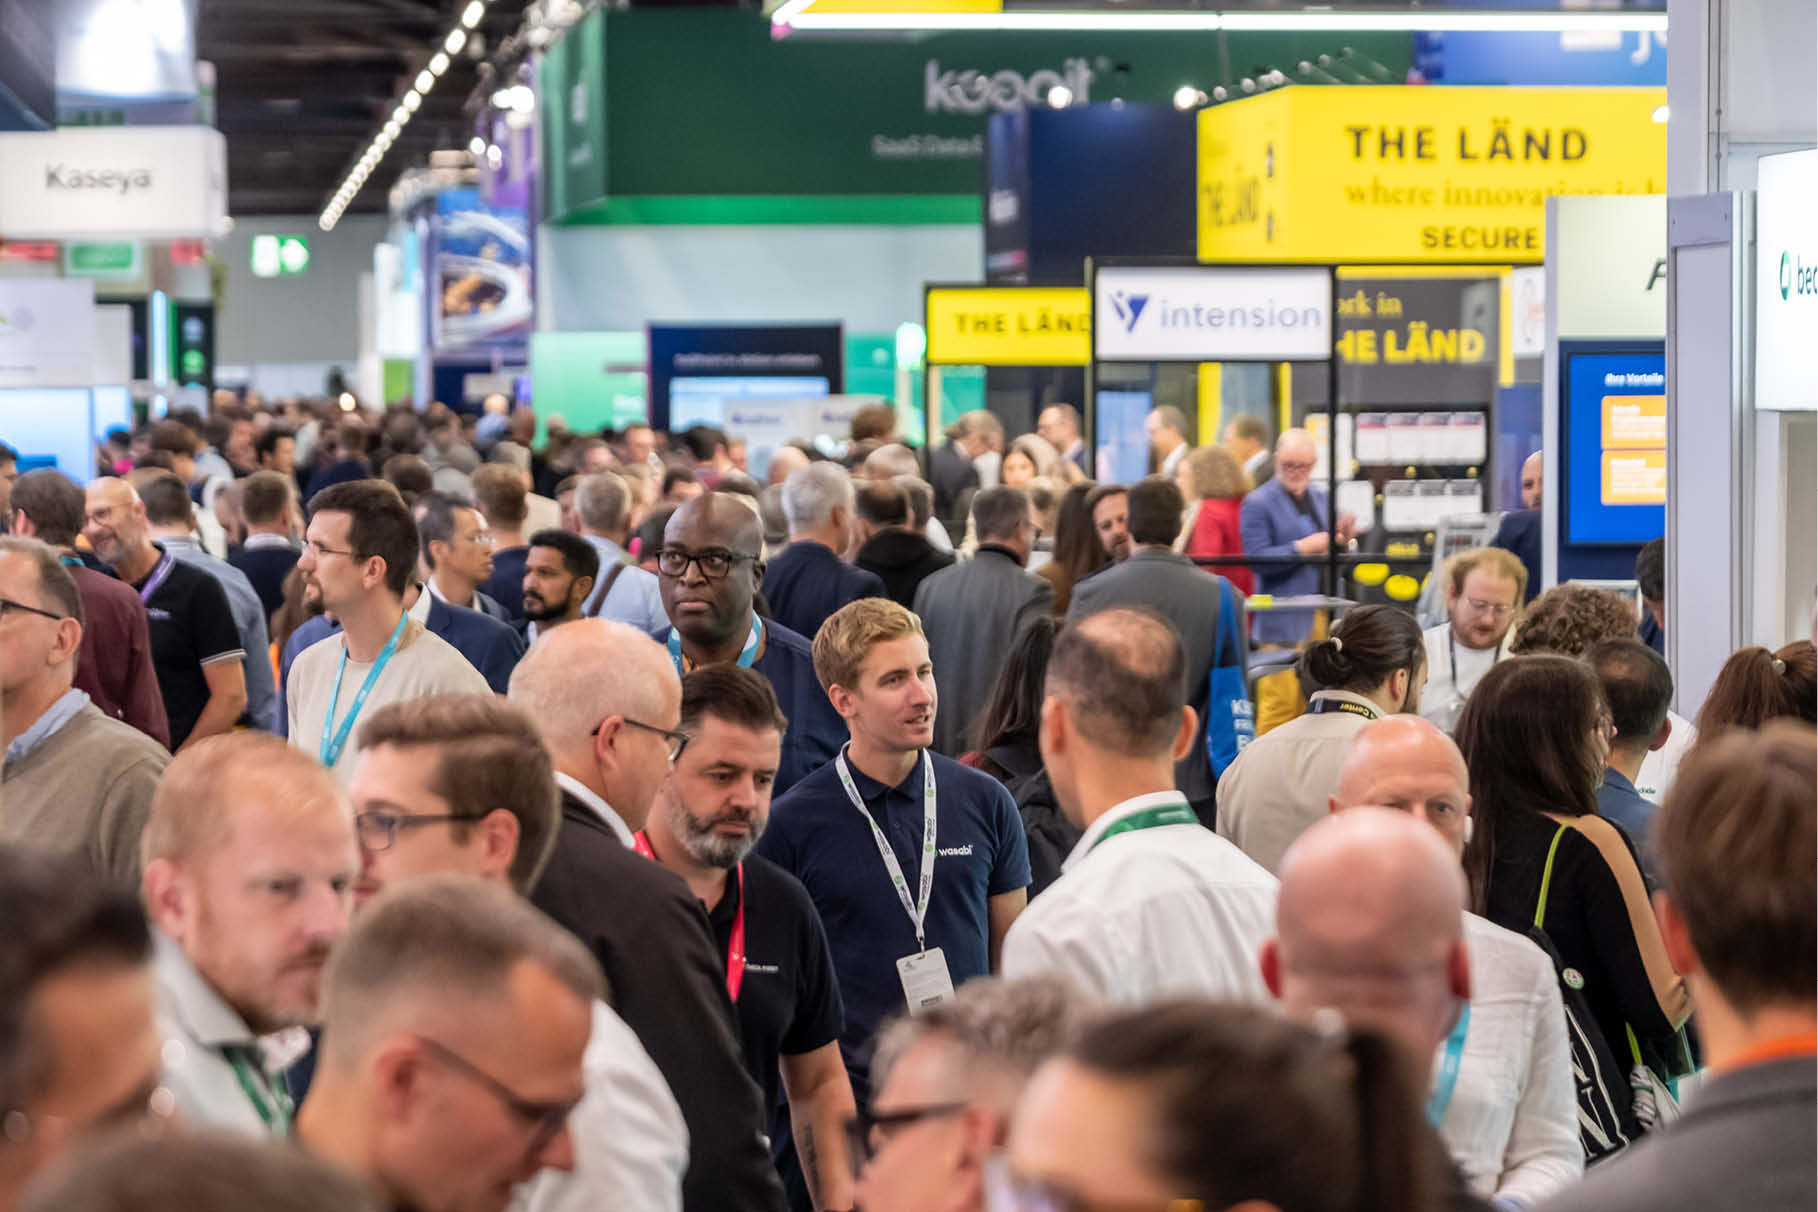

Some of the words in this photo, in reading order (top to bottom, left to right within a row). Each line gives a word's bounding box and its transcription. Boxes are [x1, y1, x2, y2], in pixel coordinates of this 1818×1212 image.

[1346, 125, 1435, 159] THE
[1458, 117, 1587, 160] LÄND
[45, 163, 152, 196] Kaseya
[1345, 176, 1436, 206] where
[1422, 226, 1539, 249] SECURE
[1161, 300, 1321, 328] intension
[1376, 291, 1403, 316] in
[955, 312, 1006, 333] THE
[1336, 329, 1377, 364] HE
[1384, 320, 1486, 364] LÄND
[938, 844, 972, 857] wasabi
